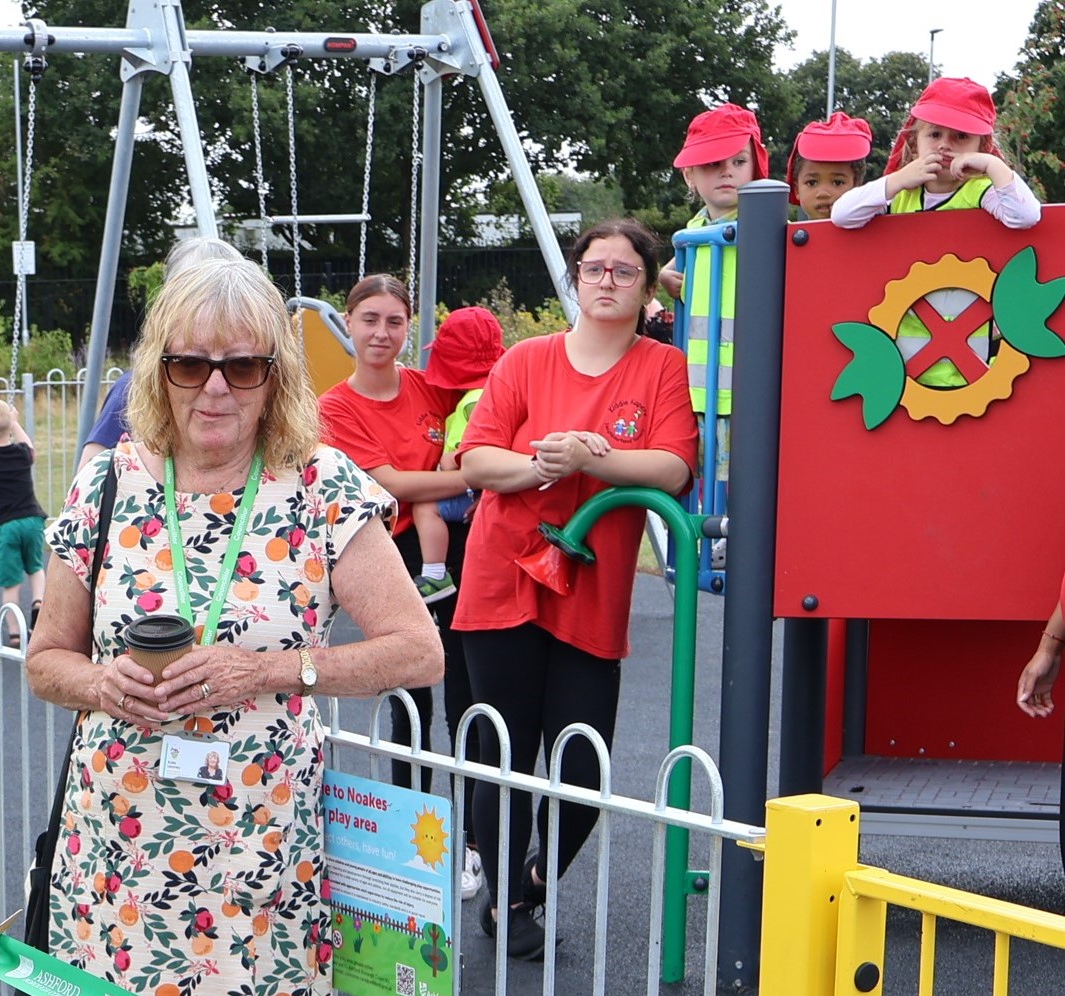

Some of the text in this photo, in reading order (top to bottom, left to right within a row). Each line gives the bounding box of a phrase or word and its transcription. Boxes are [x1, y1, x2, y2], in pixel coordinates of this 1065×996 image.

[234, 507, 248, 541] Councillor
[216, 567, 230, 602] Councillor
[333, 784, 345, 800] to
[347, 786, 388, 812] Noakes
[328, 808, 378, 833] play area
